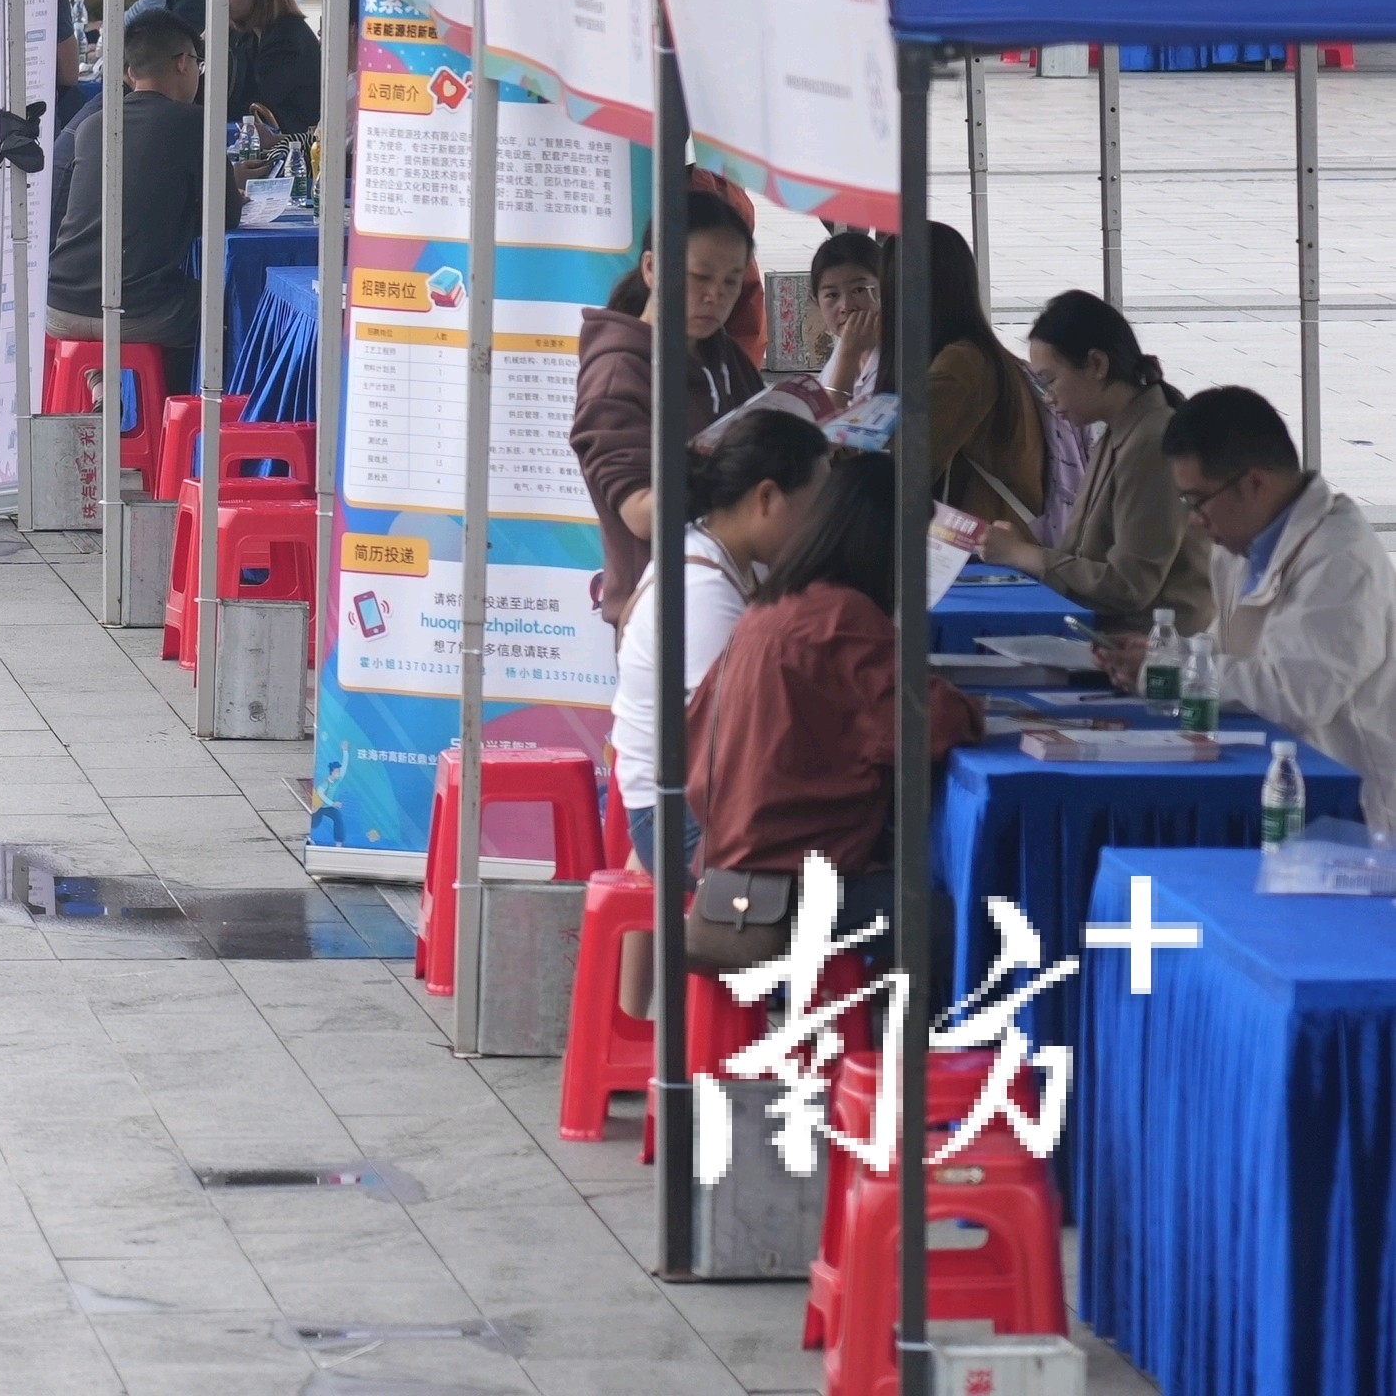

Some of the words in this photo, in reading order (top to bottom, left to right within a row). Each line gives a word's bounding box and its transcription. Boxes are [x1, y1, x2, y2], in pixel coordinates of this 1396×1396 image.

[367, 83, 419, 102] 公司简介
[361, 279, 417, 299] 招聘岗位
[434, 332, 448, 341] 人数
[354, 544, 415, 564] 简历投递
[434, 592, 560, 612] 请将投递至此邮箱
[434, 640, 561, 660] 想了多信息请联系
